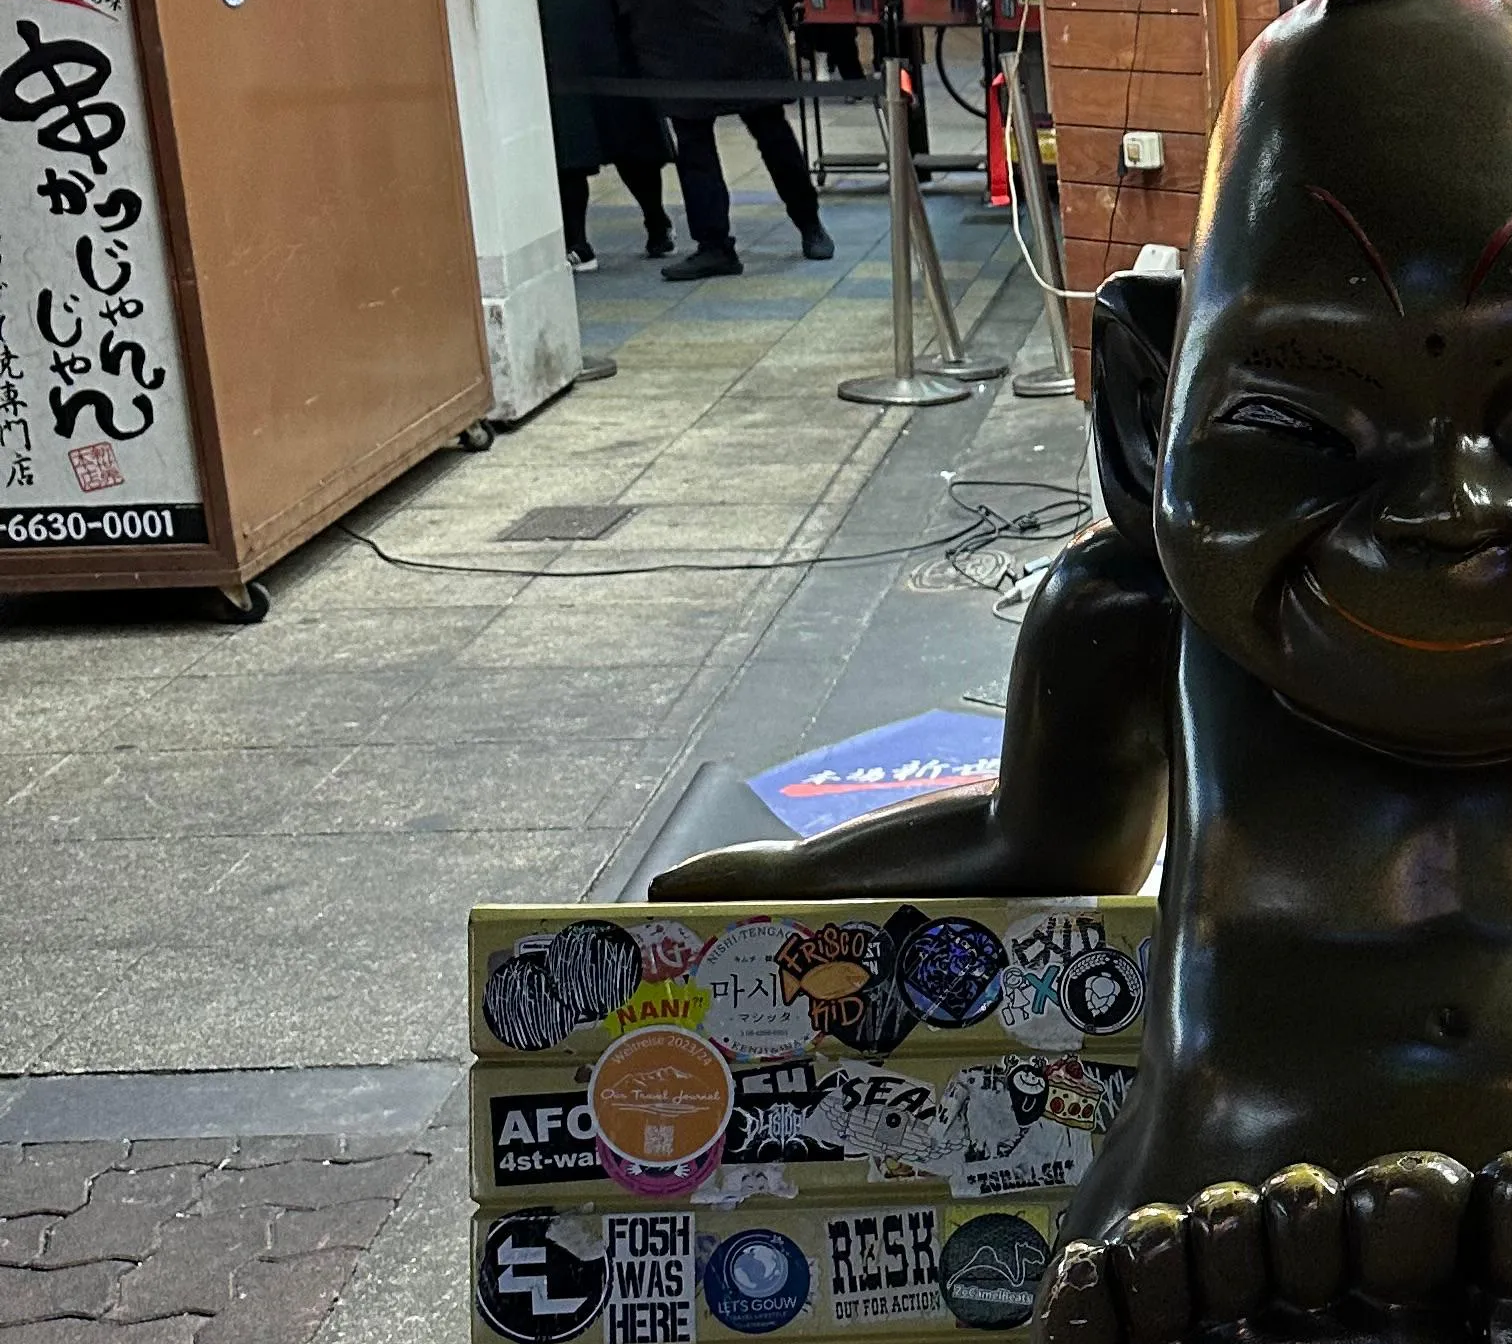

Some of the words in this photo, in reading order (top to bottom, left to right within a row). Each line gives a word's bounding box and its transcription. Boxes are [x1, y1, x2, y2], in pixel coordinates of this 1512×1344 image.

[0, 20, 142, 233] 串かつ
[76, 235, 166, 390] じゃん
[37, 288, 154, 441] じゃん
[668, 1035, 713, 1067] 2023/24
[601, 1088, 628, 1100] Our
[672, 1088, 721, 1103] Journal
[828, 1210, 939, 1294] RESK
[616, 1259, 684, 1299] WAS
[609, 1301, 691, 1344] HERE
[751, 1297, 797, 1311] GOUW
[836, 1300, 860, 1319] OUT
[863, 1296, 890, 1316] FOR
[892, 1292, 940, 1312] ACTION
